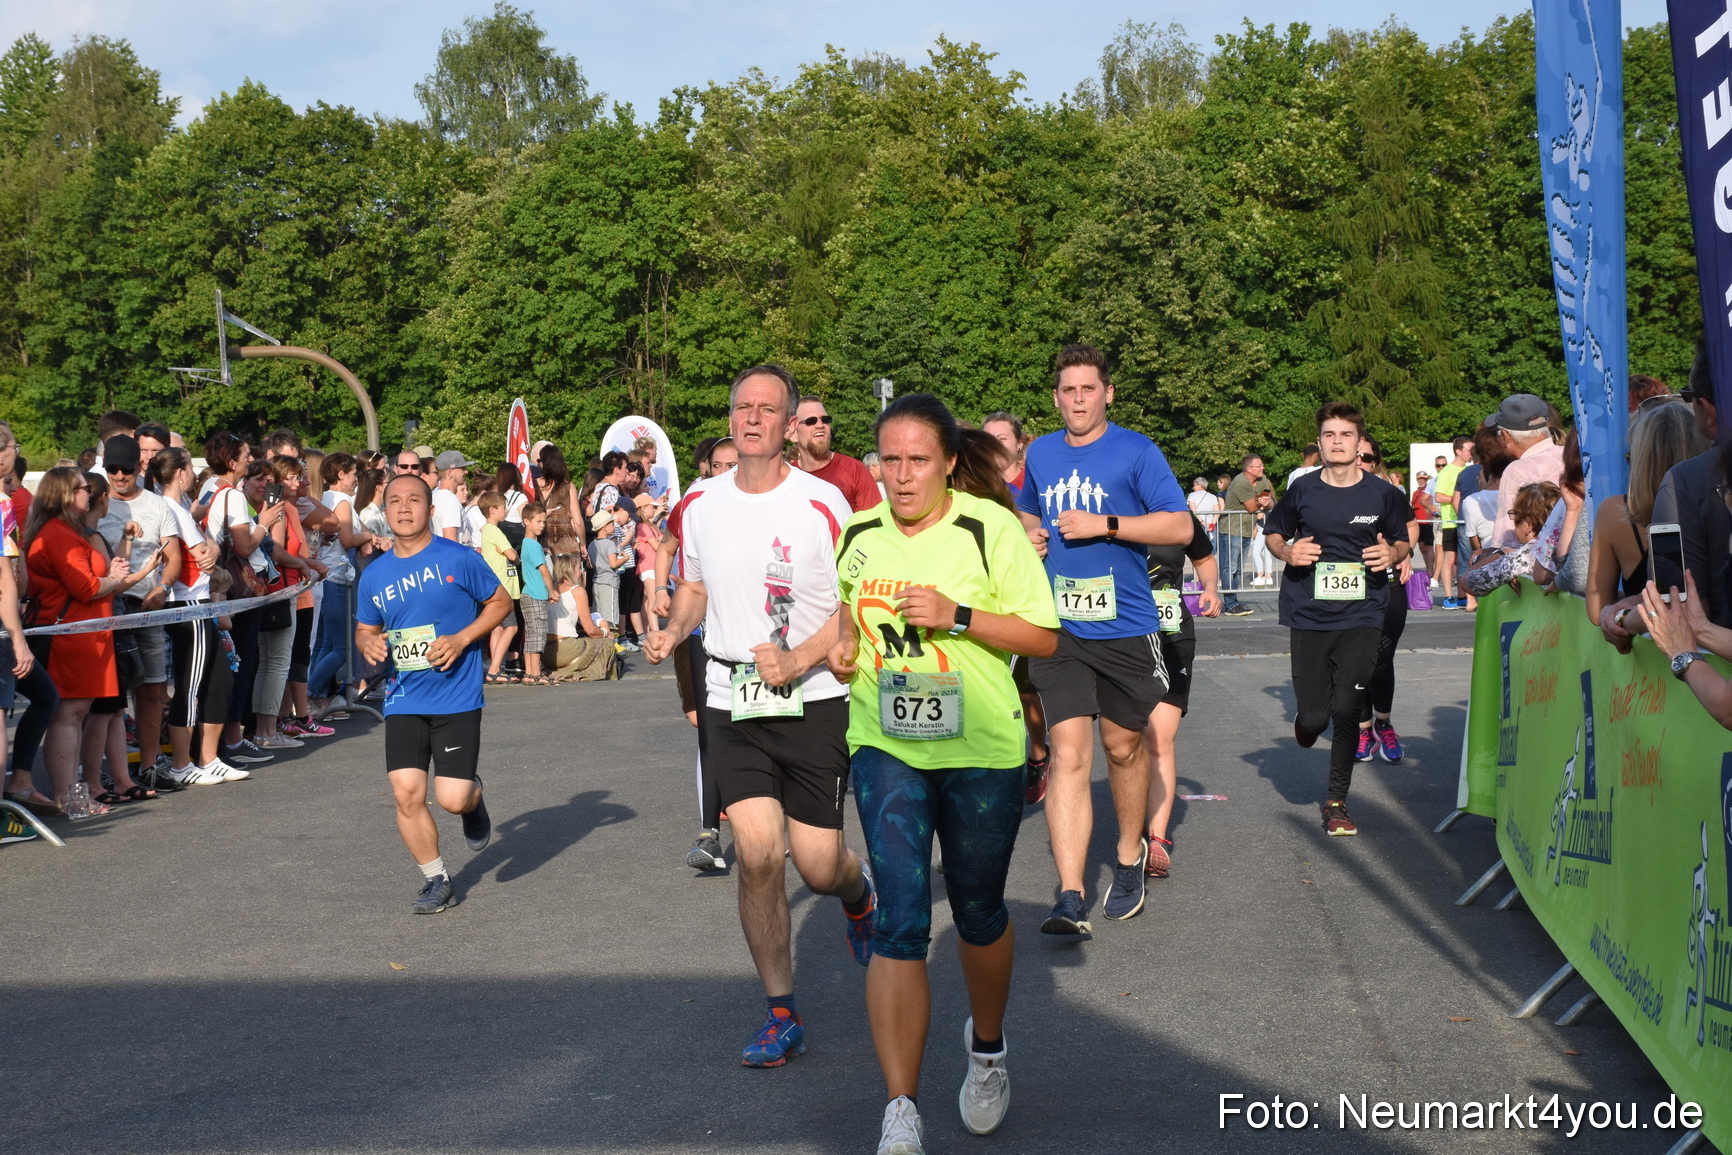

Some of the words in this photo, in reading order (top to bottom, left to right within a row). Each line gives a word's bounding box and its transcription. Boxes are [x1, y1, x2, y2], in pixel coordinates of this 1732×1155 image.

[1322, 576, 1359, 589] 1384
[1061, 592, 1107, 609] 1714
[877, 623, 924, 659] M
[395, 641, 429, 660] 2042
[893, 696, 943, 721] 673
[893, 720, 917, 729] Salukat
